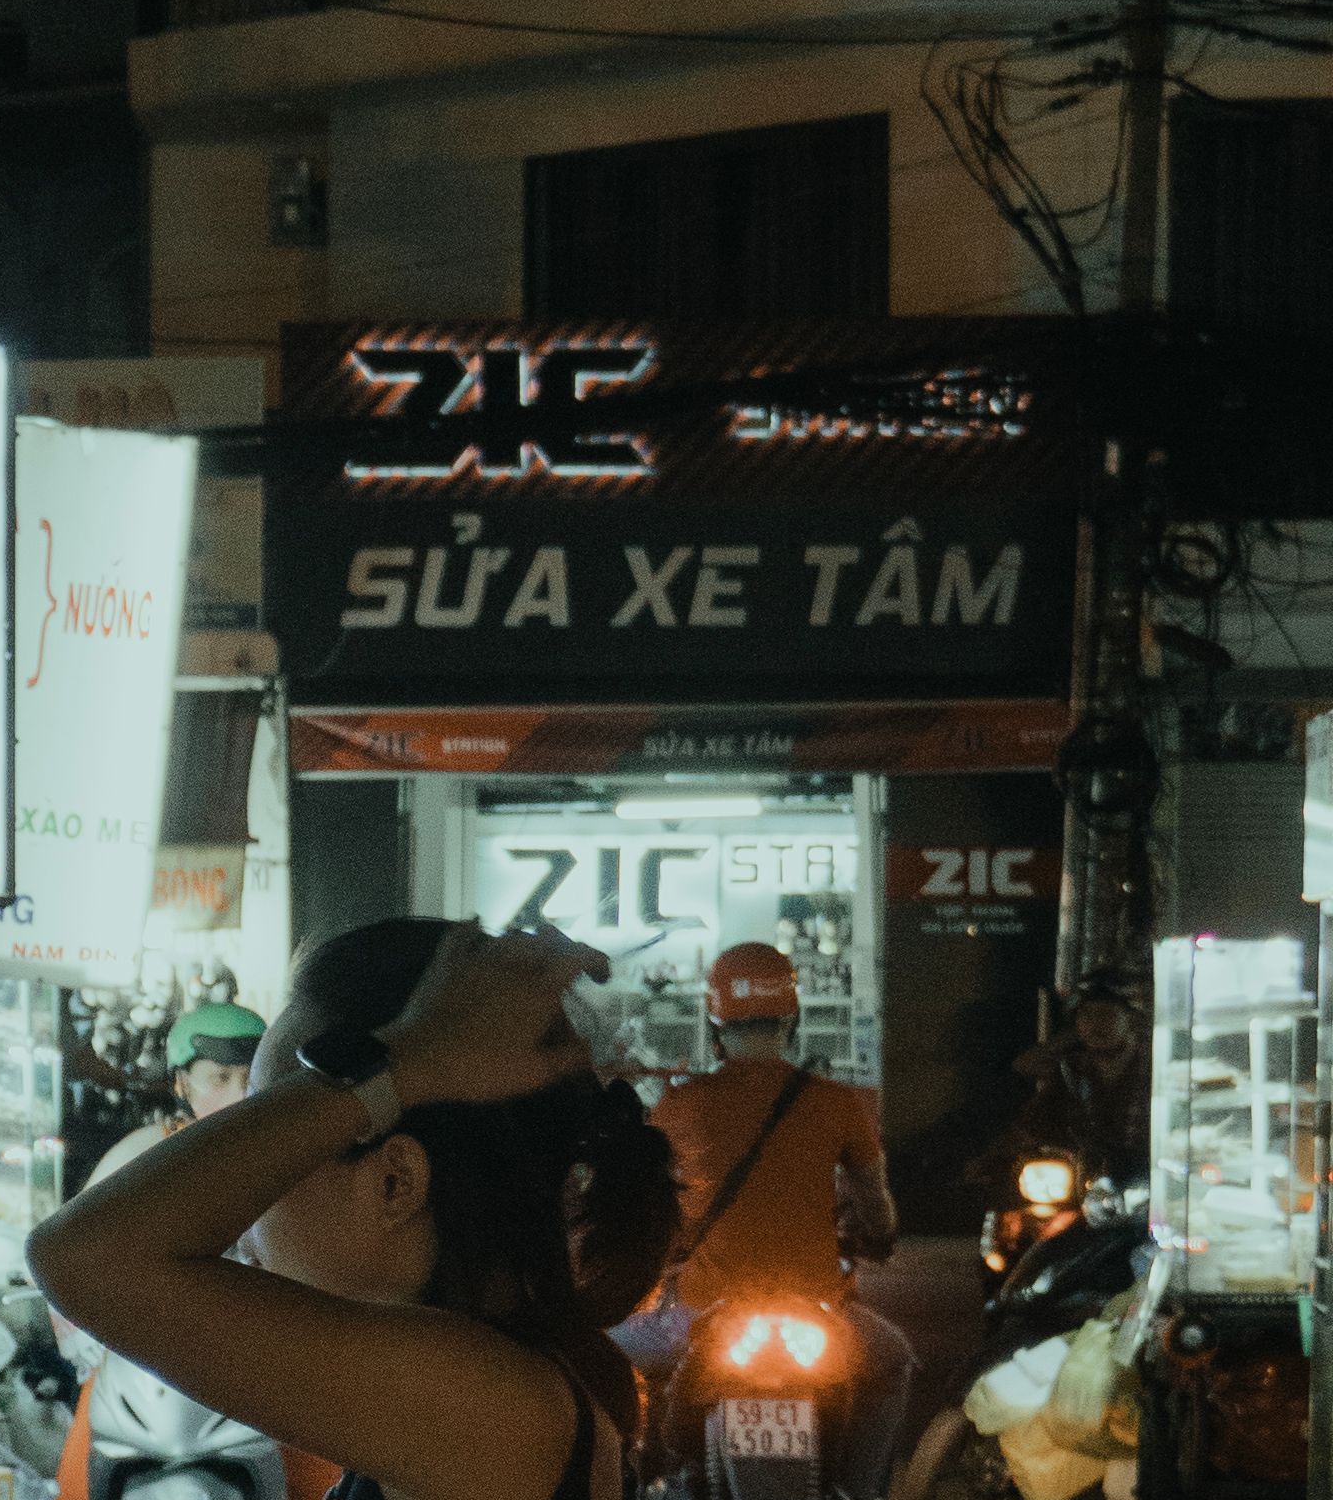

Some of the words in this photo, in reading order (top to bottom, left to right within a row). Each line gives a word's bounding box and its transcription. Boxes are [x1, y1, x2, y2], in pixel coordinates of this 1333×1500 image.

[343, 339, 660, 479] ZIC
[341, 512, 574, 629] SỬA
[611, 545, 760, 629] XE
[804, 517, 1025, 627] TÂM
[501, 847, 711, 931] ZIC
[728, 843, 858, 885] STA
[920, 849, 1034, 897] ZIC
